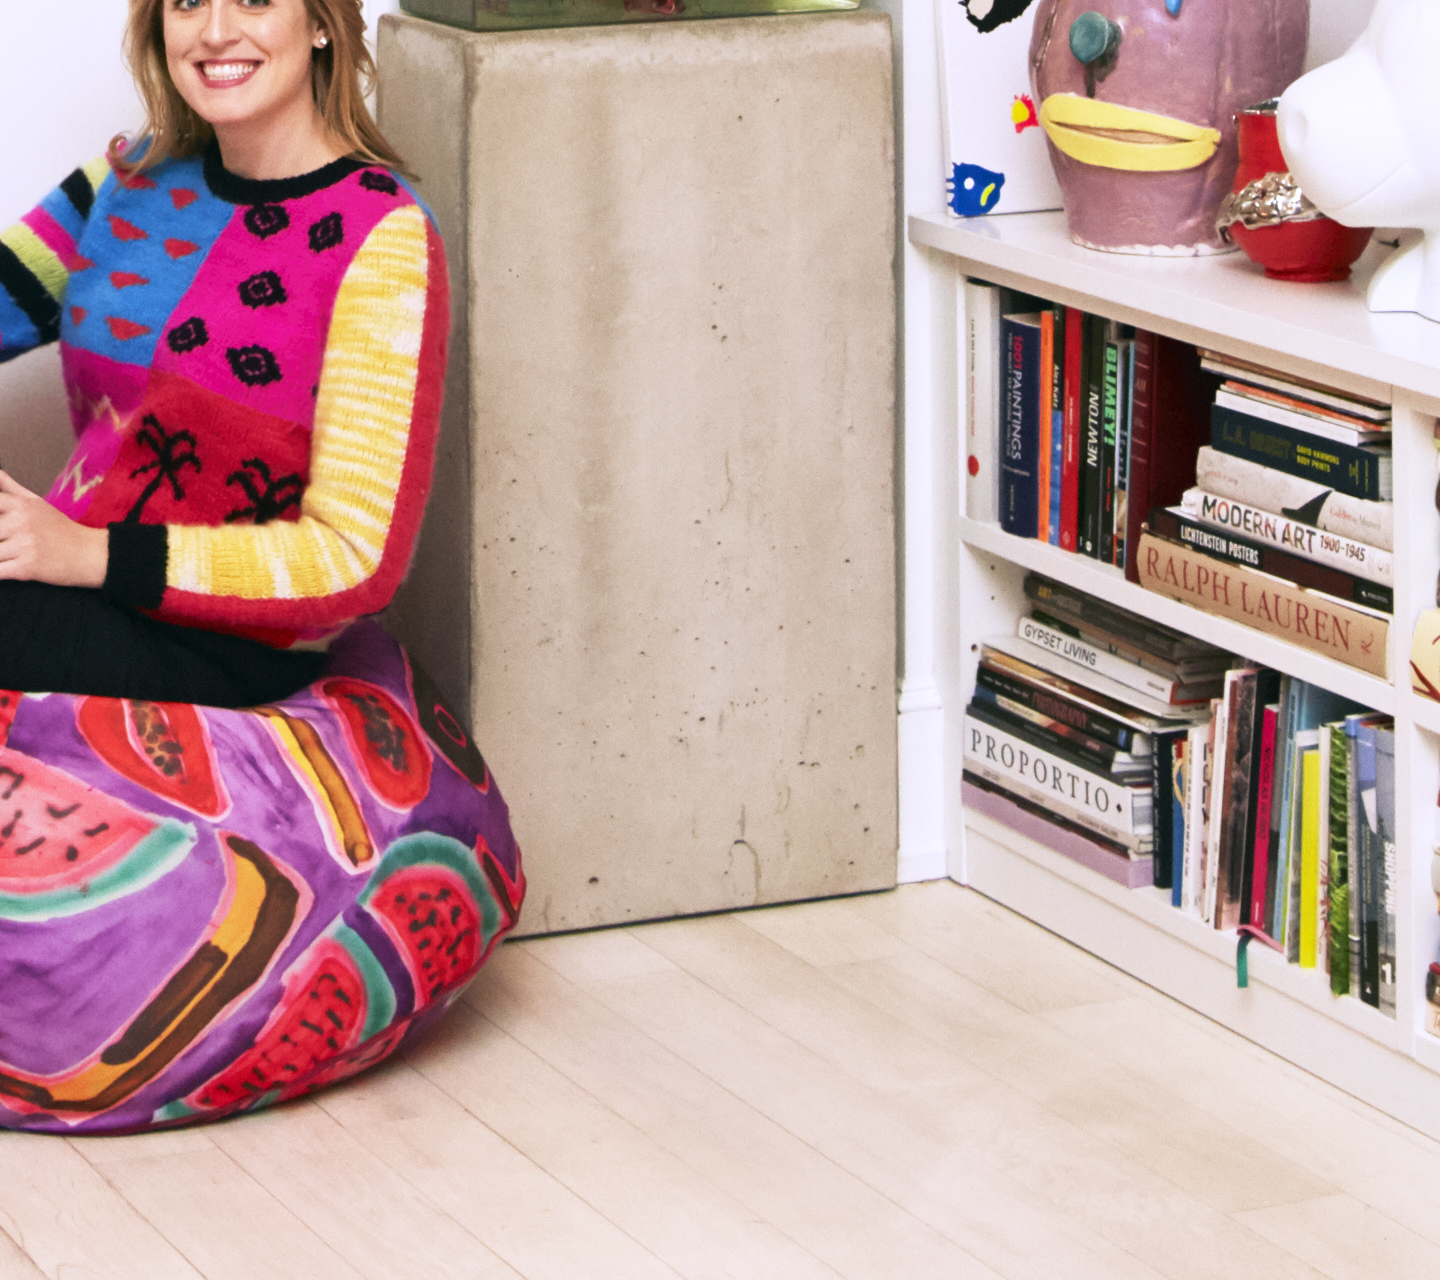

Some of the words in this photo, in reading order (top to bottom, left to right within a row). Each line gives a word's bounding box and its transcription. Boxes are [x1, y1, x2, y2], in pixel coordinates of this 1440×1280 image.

[1013, 335, 1023, 371] 1001
[1010, 369, 1023, 461] PAINTINGS
[1086, 391, 1100, 468] NEWTON
[1104, 346, 1119, 447] BLIMEY!
[1180, 524, 1228, 556] LICHTENSTEIN
[1228, 537, 1260, 565] POSTERS
[1202, 493, 1277, 542] MODERN
[1281, 522, 1318, 554] ART
[1319, 533, 1367, 563] 1900-1945
[1145, 545, 1233, 608] RALPH
[1241, 579, 1353, 653] LAUREN
[1023, 623, 1063, 650] GYPSET
[1063, 642, 1097, 667] LIVING
[970, 727, 1110, 813] PROPORTIO
